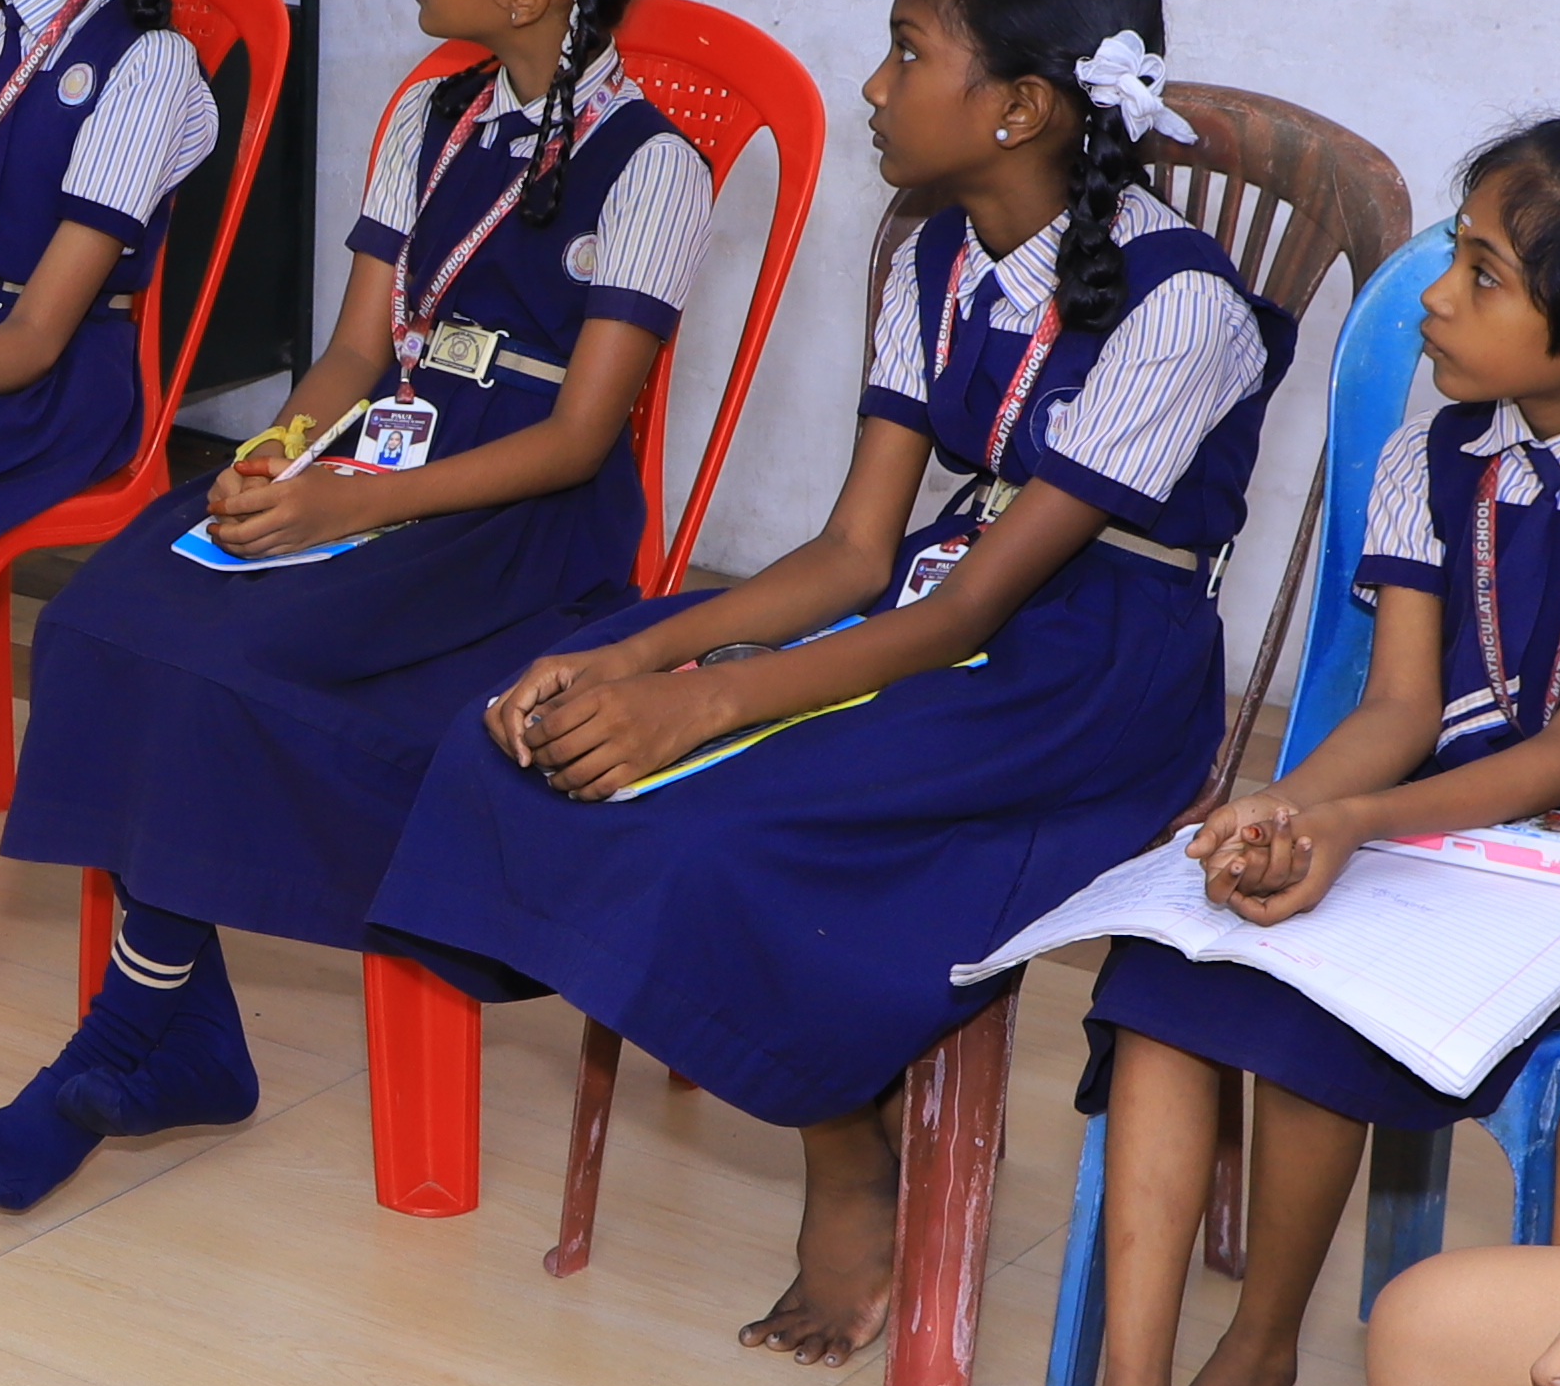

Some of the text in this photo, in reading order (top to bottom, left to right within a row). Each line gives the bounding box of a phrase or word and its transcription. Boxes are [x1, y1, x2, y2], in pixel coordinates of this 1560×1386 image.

[15, 41, 49, 86] SCHOOL
[394, 294, 406, 326] PAUL
[430, 141, 461, 189] SCHOOL
[418, 294, 437, 319] PAUL
[430, 207, 501, 295] MATRICULATION
[939, 290, 955, 349] SCHOOL
[1014, 341, 1051, 398] SCHOOL
[1476, 497, 1490, 561] SCHOOL
[1477, 566, 1505, 697] MATRICULATION
